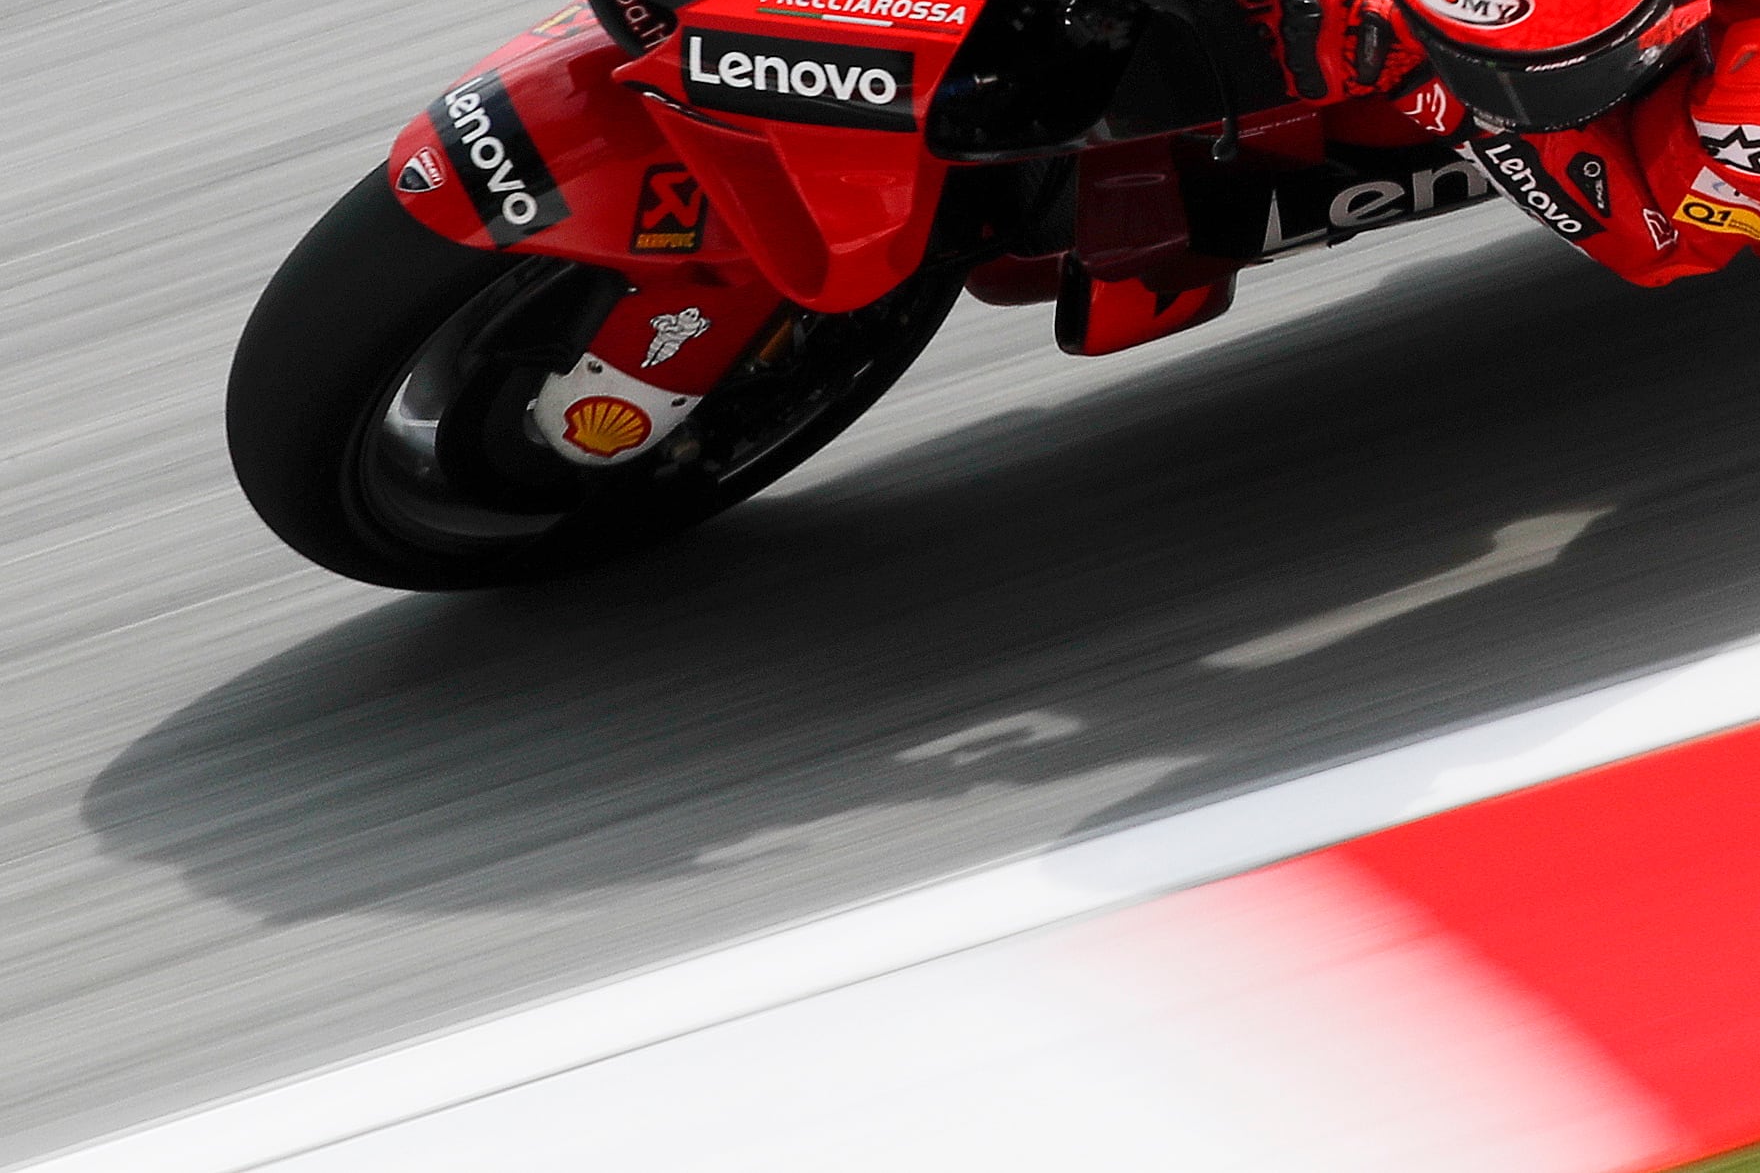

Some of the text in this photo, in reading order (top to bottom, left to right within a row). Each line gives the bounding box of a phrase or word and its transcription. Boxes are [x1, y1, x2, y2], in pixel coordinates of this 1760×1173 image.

[688, 35, 898, 107] Lenovo
[444, 76, 539, 228] Lenovo
[1484, 141, 1584, 236] Lenovo
[1683, 200, 1733, 227] Q1
